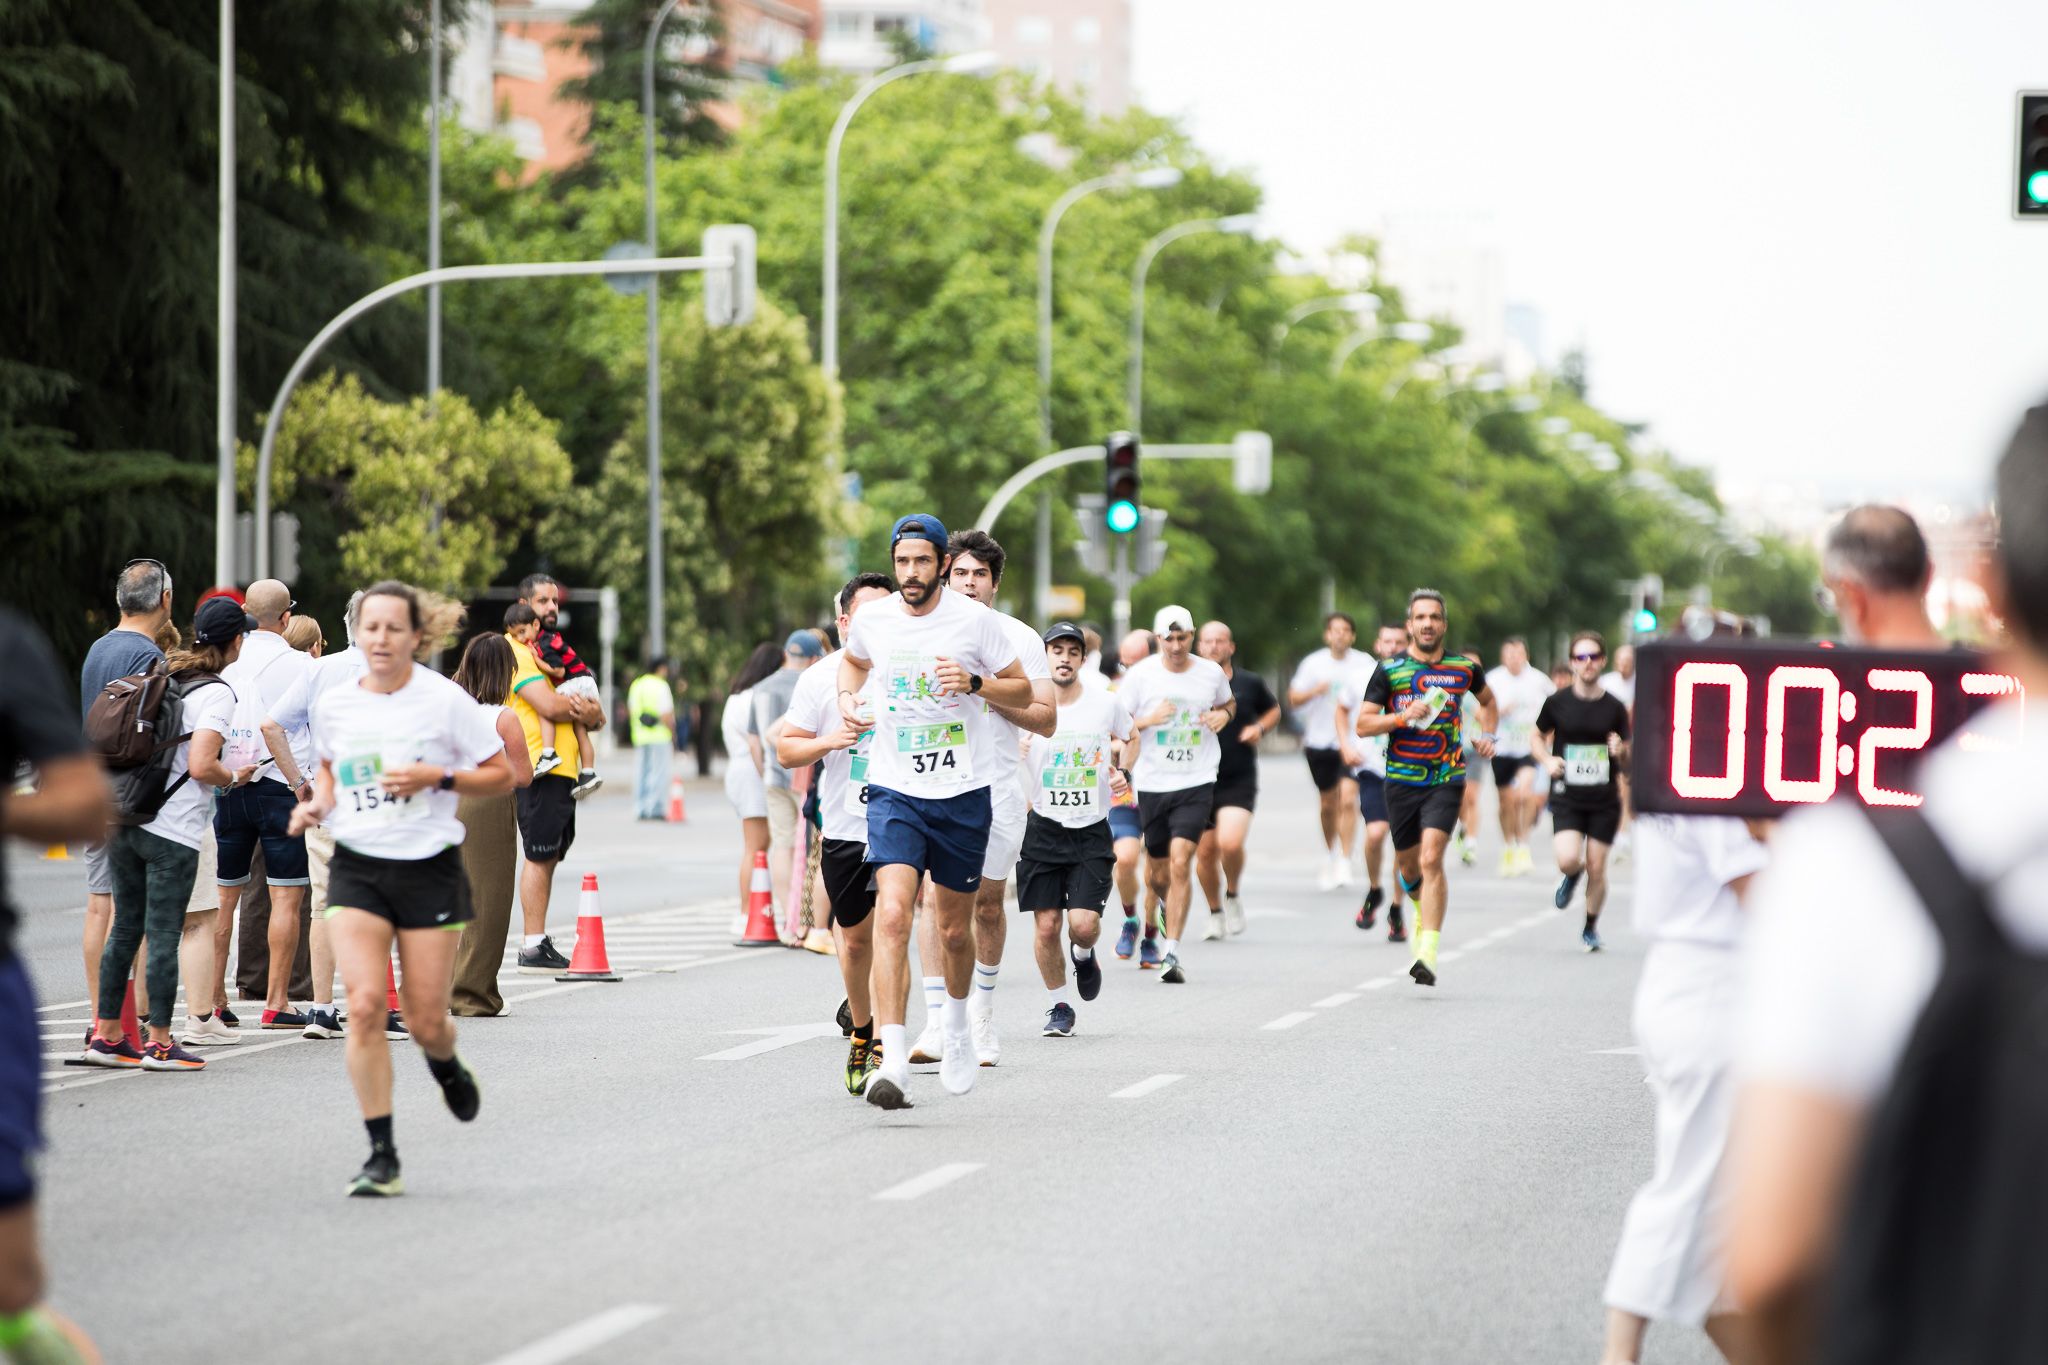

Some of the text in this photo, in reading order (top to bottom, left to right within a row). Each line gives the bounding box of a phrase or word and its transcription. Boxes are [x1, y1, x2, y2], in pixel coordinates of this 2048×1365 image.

[912, 750, 956, 774] 374
[1166, 749, 1194, 762] 425
[1050, 790, 1091, 806] 1231
